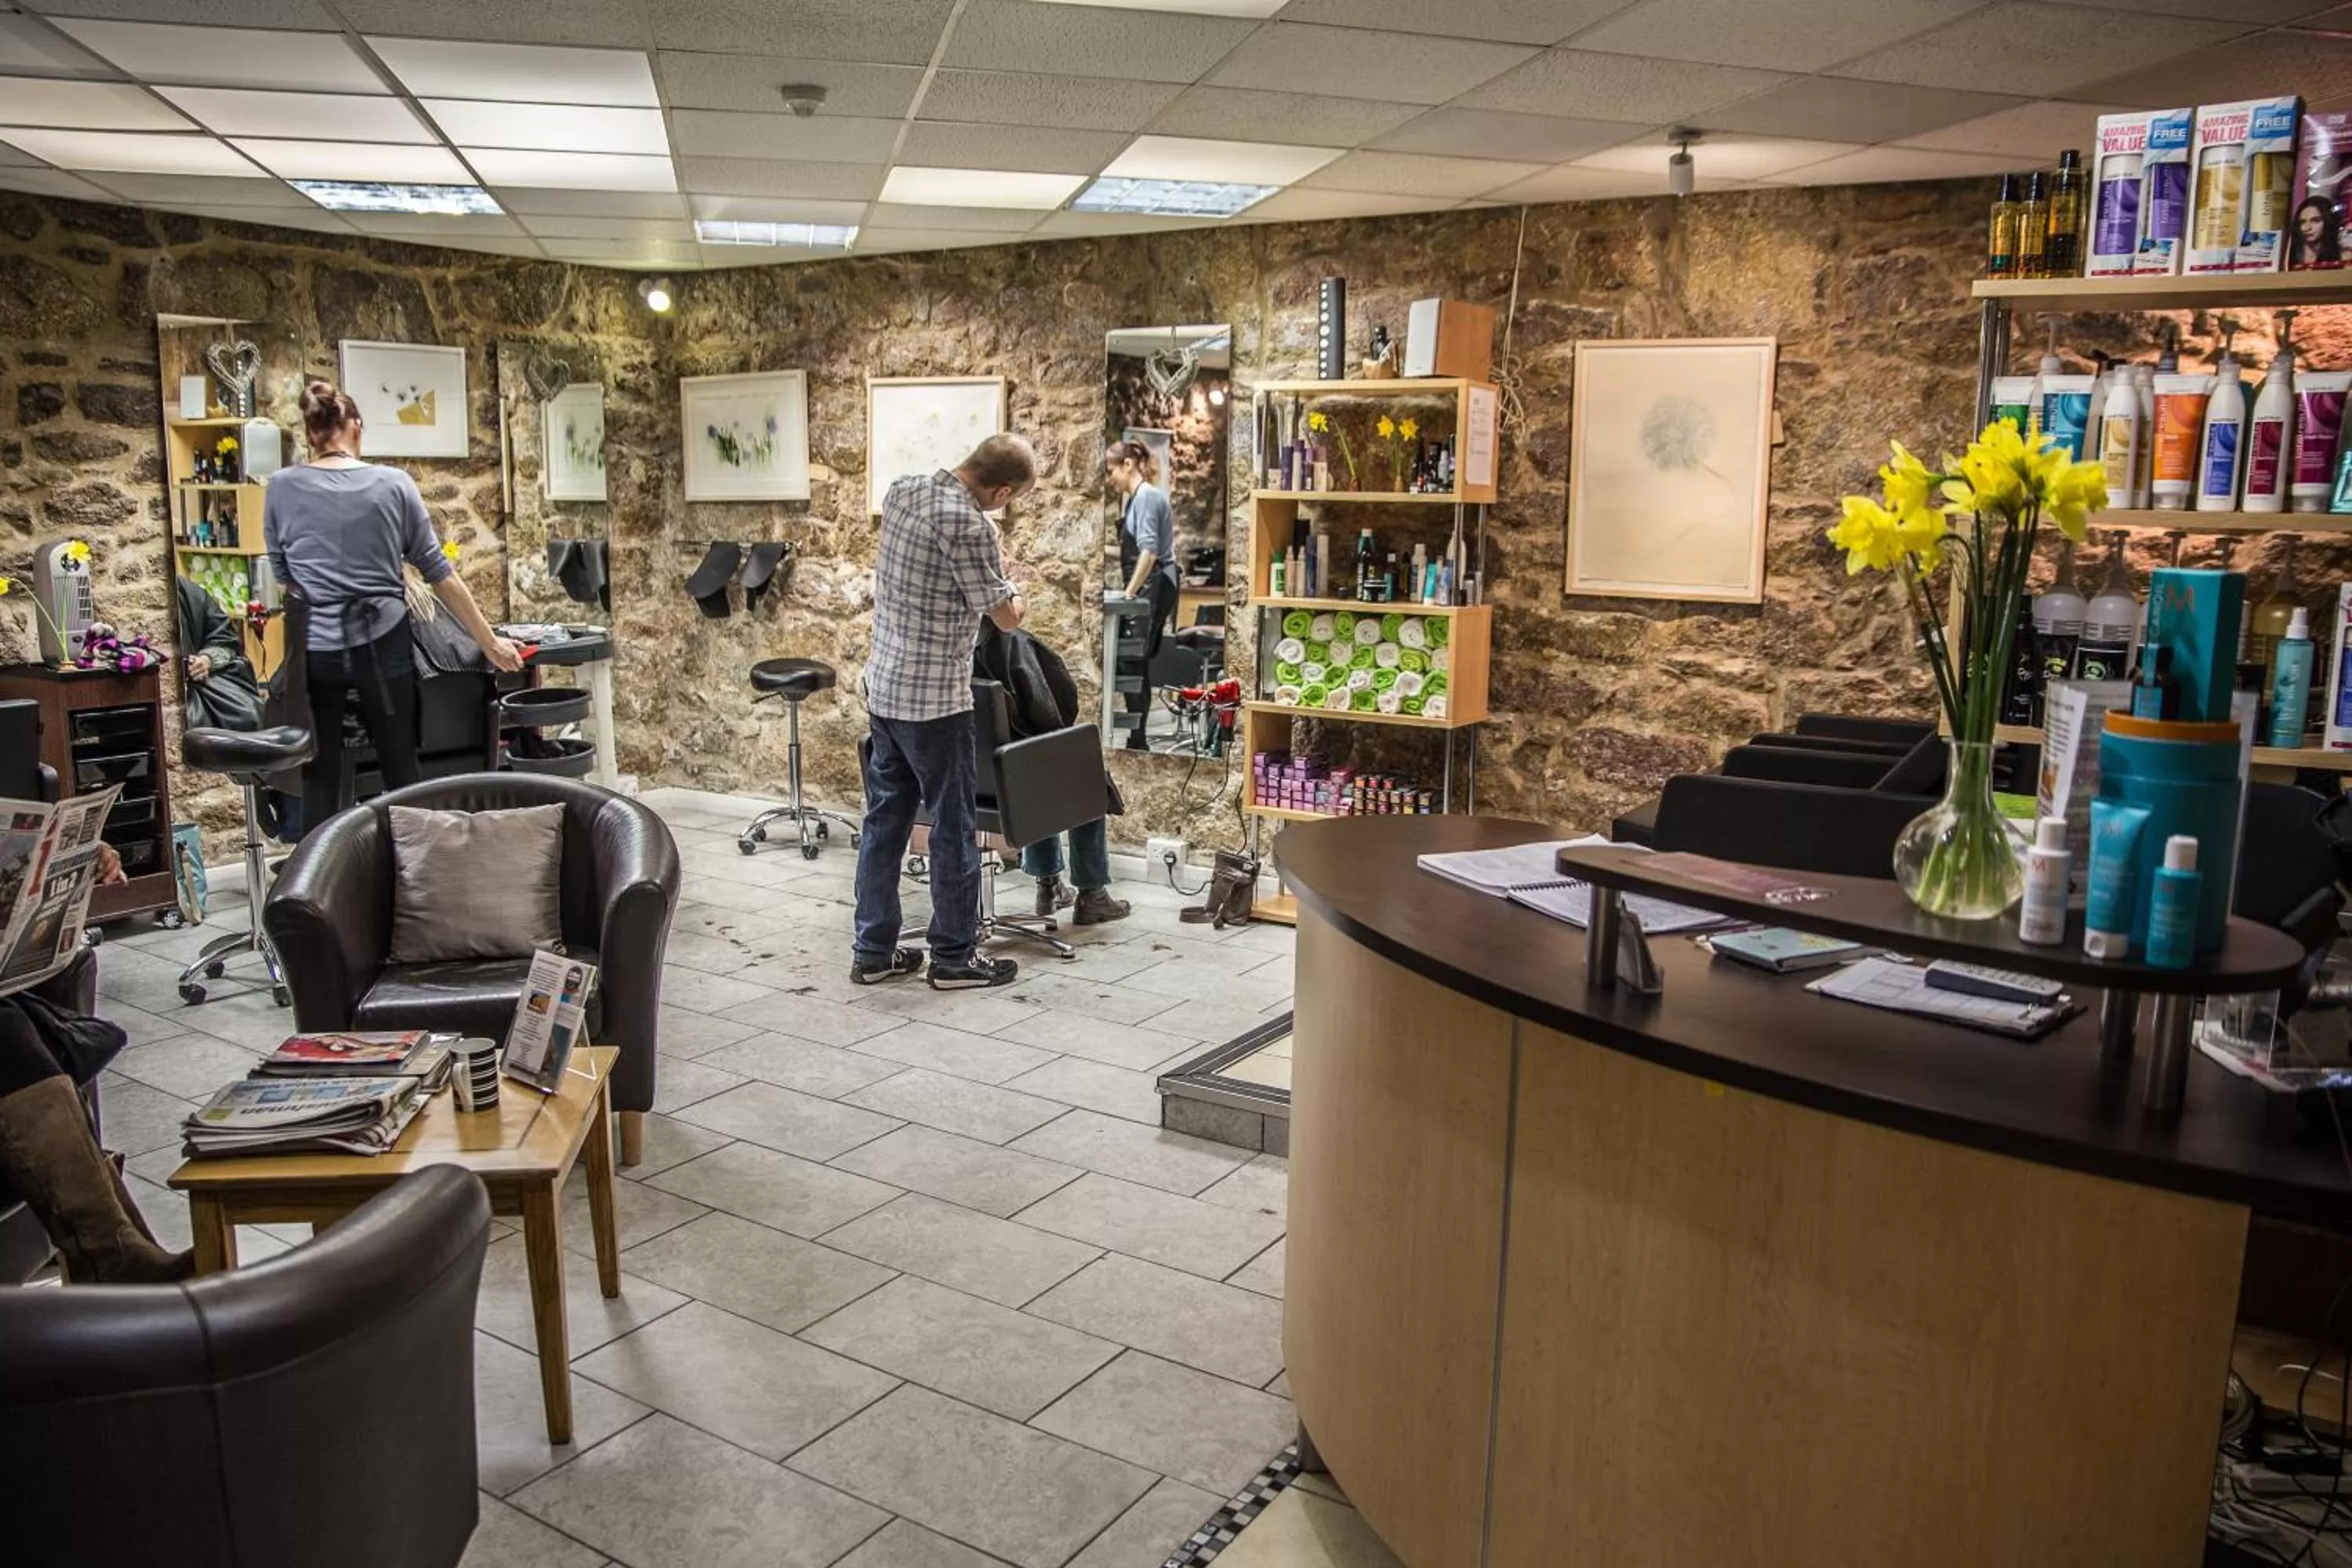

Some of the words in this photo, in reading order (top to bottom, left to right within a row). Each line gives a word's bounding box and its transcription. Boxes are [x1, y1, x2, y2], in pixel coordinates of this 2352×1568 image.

[2202, 114, 2249, 127] AMAZING
[2257, 115, 2292, 129] FREE
[2103, 125, 2147, 136] AMAZING
[2154, 128, 2187, 140] FREE
[2201, 125, 2247, 143] VALUE
[2103, 136, 2146, 151] VALUE
[2165, 584, 2195, 614] M
[2031, 858, 2045, 873] M
